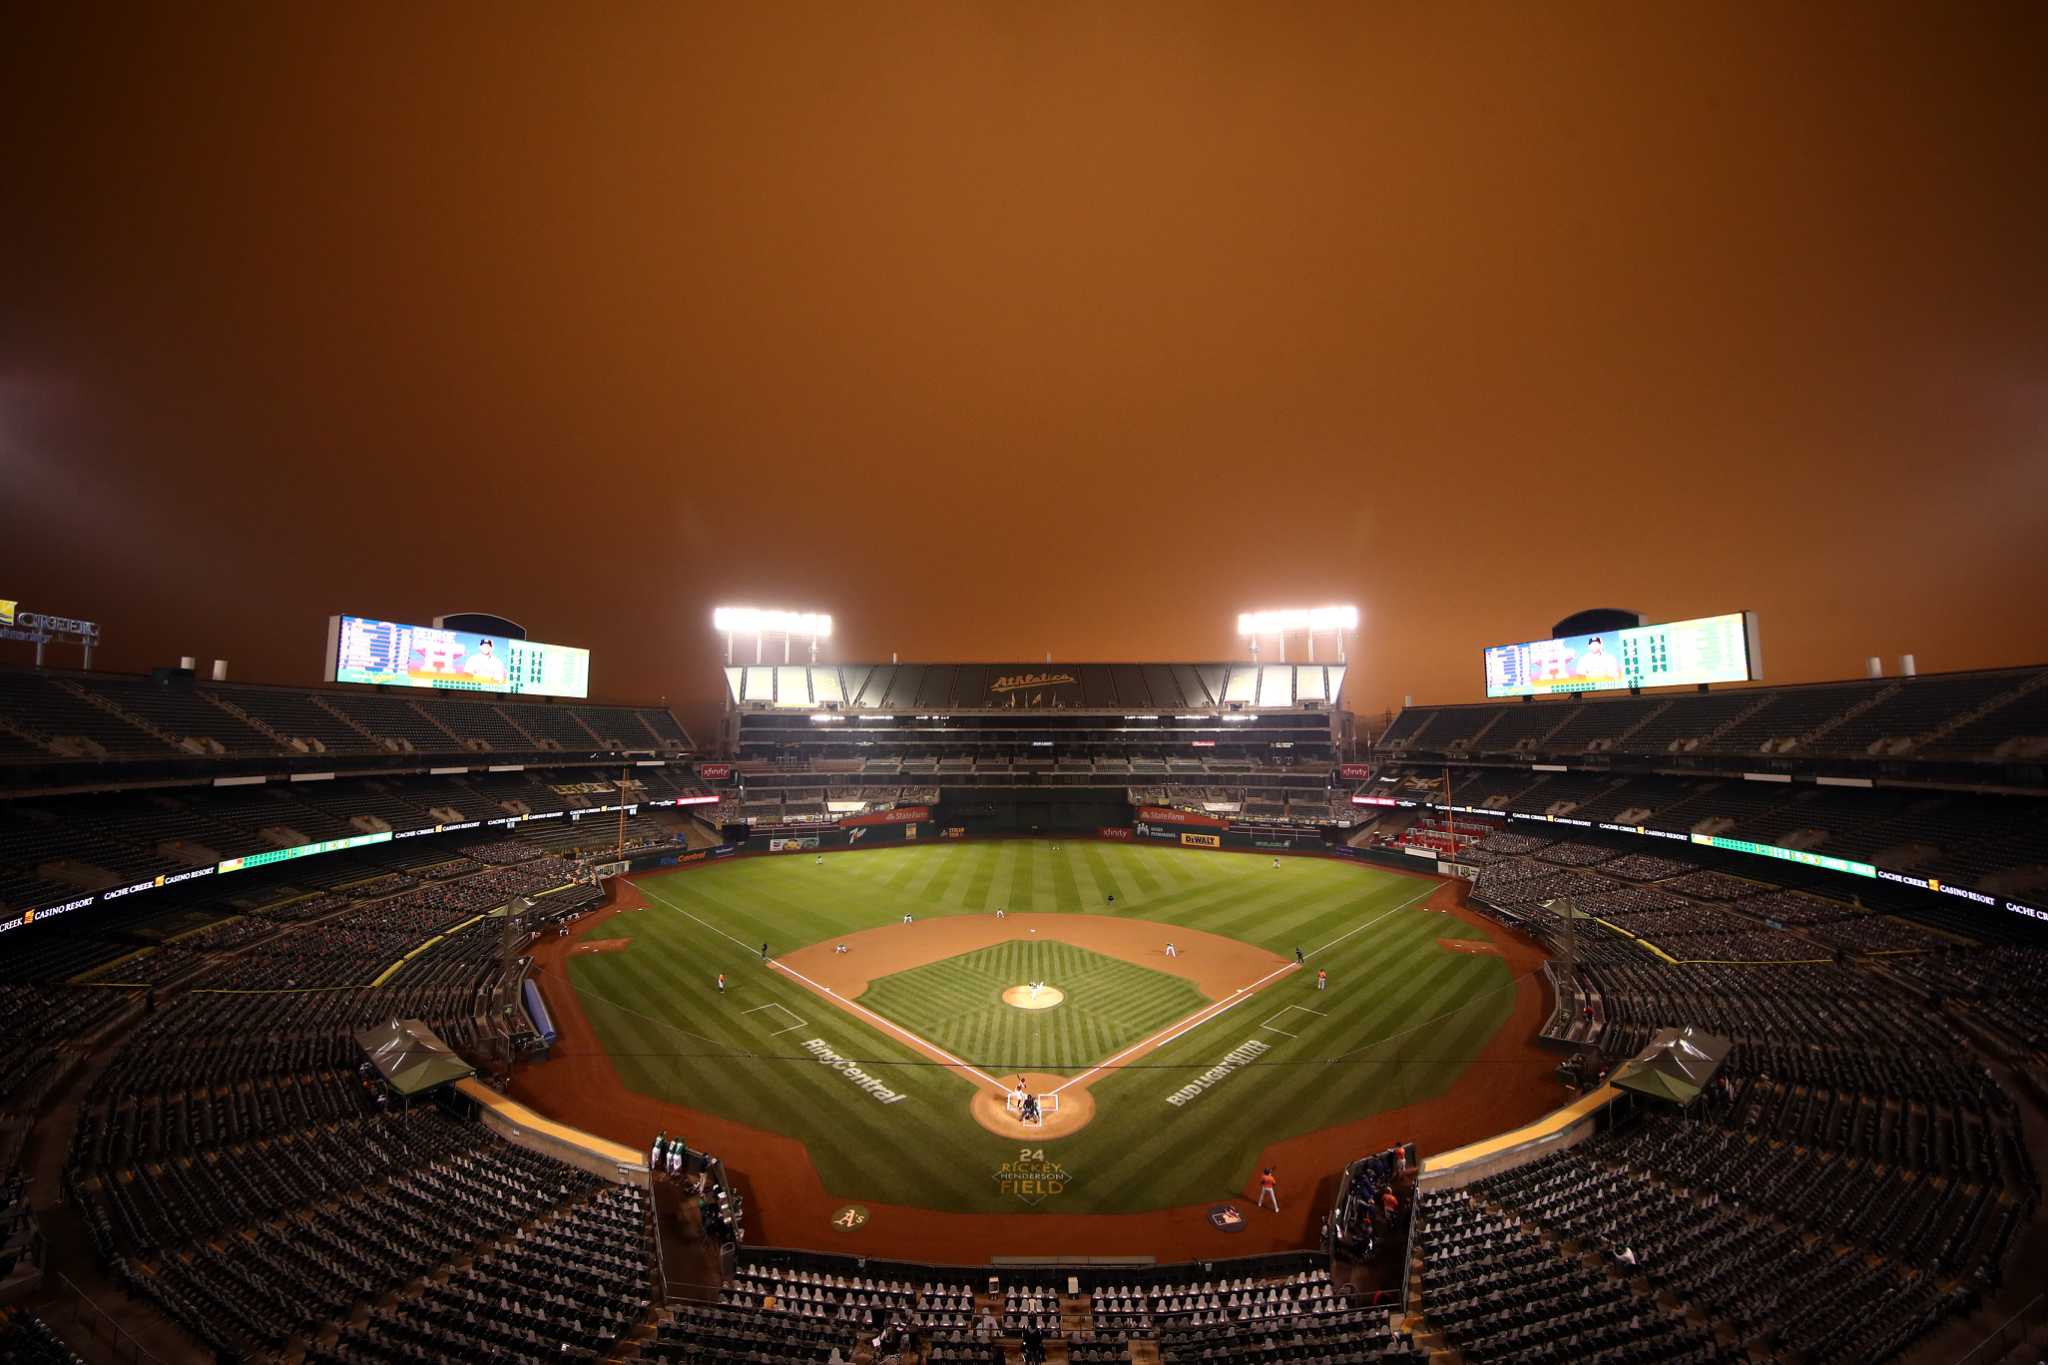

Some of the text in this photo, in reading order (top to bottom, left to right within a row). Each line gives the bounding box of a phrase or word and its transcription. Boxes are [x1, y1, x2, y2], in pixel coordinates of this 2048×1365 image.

[1103, 828, 1128, 839] xfinity
[103, 867, 215, 900] CACHE CREEK CASINO RESORT
[1878, 870, 1995, 906] CACHE CREEK CASINO RESORT
[0, 897, 94, 932] CREEK CASINO RESORT
[2005, 902, 2036, 918] CACHE
[800, 1038, 907, 1104] RingCentral
[1165, 1079, 1202, 1107] BUD
[1223, 1040, 1272, 1066] SELTZER
[1020, 1148, 1044, 1162] 24
[1001, 1162, 1062, 1173] RICKEY
[1000, 1172, 1064, 1181] HENDERSON
[1001, 1180, 1063, 1194] FIELD
